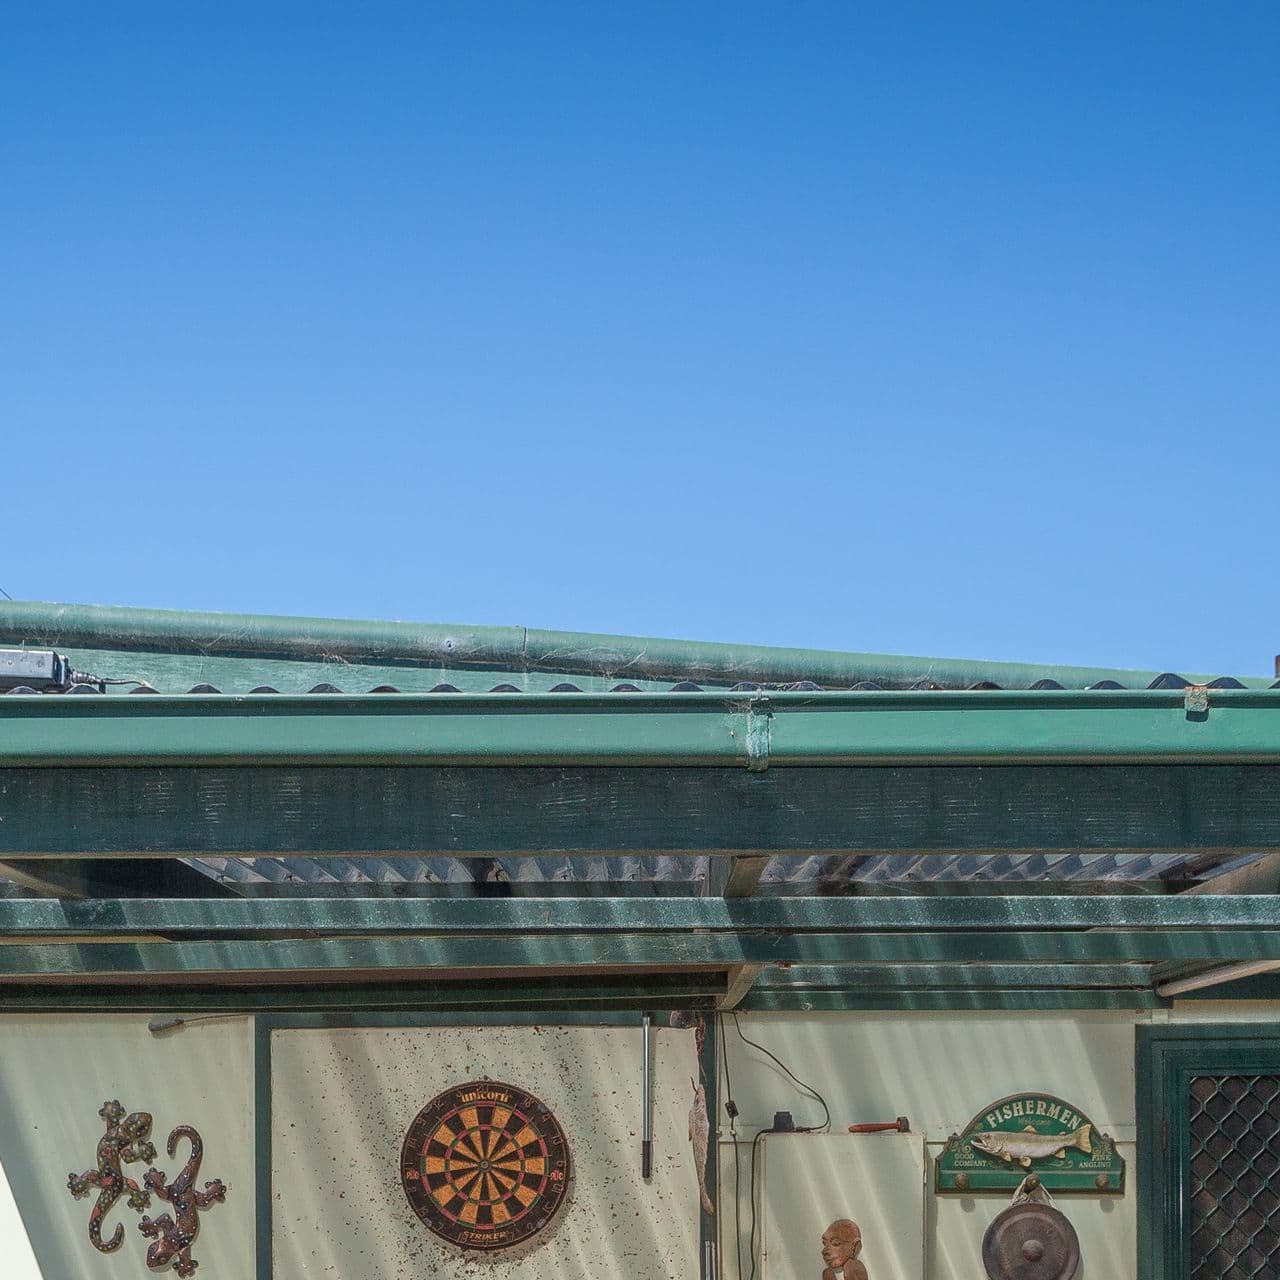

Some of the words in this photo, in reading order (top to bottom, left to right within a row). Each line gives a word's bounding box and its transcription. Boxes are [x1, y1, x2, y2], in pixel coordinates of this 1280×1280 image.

[461, 1091, 508, 1102] unicorn
[986, 1100, 1082, 1129] FISHERMEN
[1092, 1154, 1112, 1162] FINE
[1079, 1161, 1111, 1169] ANGLING
[463, 1231, 506, 1240] STRIKER
